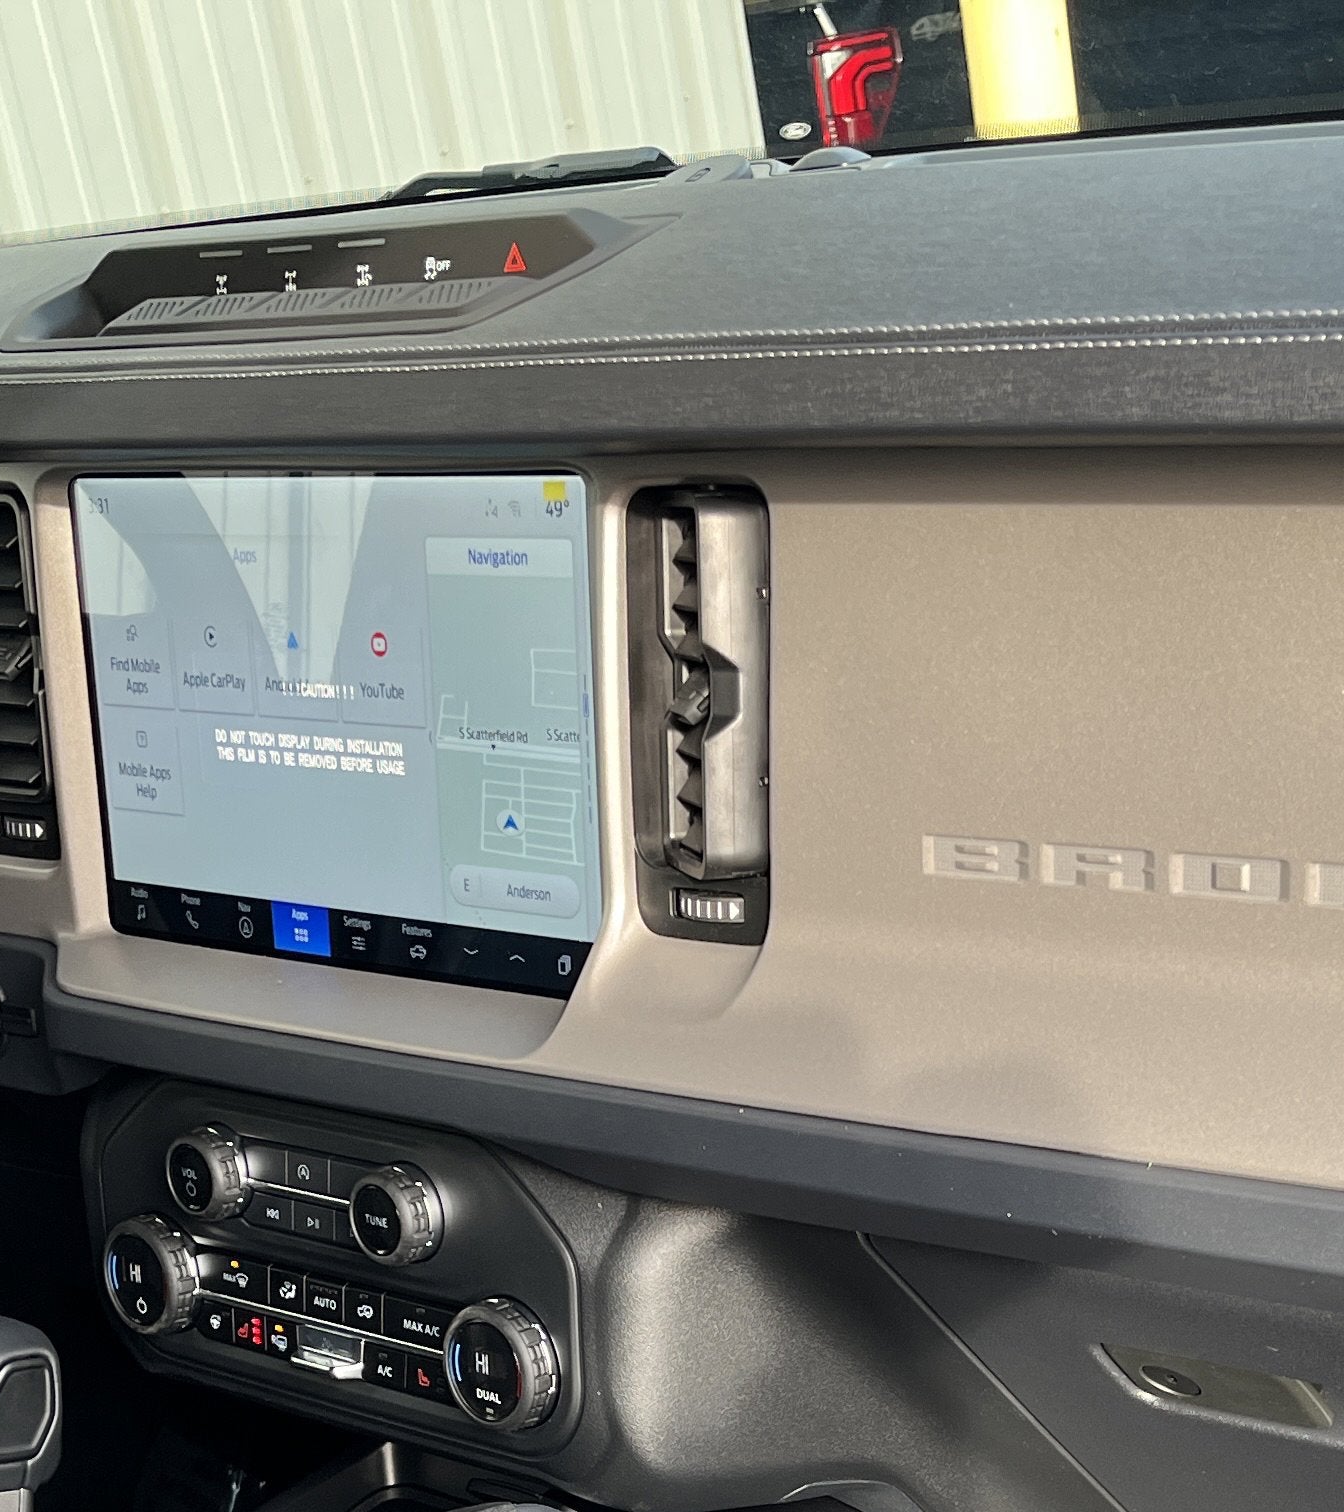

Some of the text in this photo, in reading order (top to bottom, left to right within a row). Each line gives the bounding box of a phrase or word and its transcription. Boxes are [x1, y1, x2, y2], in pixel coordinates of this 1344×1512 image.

[232, 547, 258, 564] Apps
[467, 548, 528, 569] Navigation
[110, 657, 161, 674] Find Mobile
[126, 678, 149, 695] Apps
[183, 671, 246, 692] Apple CarPlay
[301, 682, 336, 699] CAUTION
[360, 682, 405, 700] YouTube
[215, 728, 404, 757] DO NOT TOUCH DISPLAY DURING INSTALLATION
[467, 727, 515, 743] Scatterfield
[517, 731, 529, 743] Rd
[216, 746, 406, 776] THIS FILM IS TO BE REMOVED BEFORE USAGE
[119, 761, 172, 781] Mobile Apps
[136, 783, 158, 800] Help
[463, 878, 552, 901] E Anderson
[291, 908, 309, 922] Apps
[343, 915, 372, 932] Settings
[401, 923, 433, 938] Features
[181, 1166, 197, 1180] VOL
[364, 1213, 388, 1229] TUNE
[129, 1262, 142, 1284] HI
[313, 1296, 337, 1311] AUTO
[403, 1318, 440, 1338] MAX A/C
[377, 1364, 393, 1378] A/C
[475, 1351, 490, 1376] HI
[476, 1387, 502, 1405] DUAL
